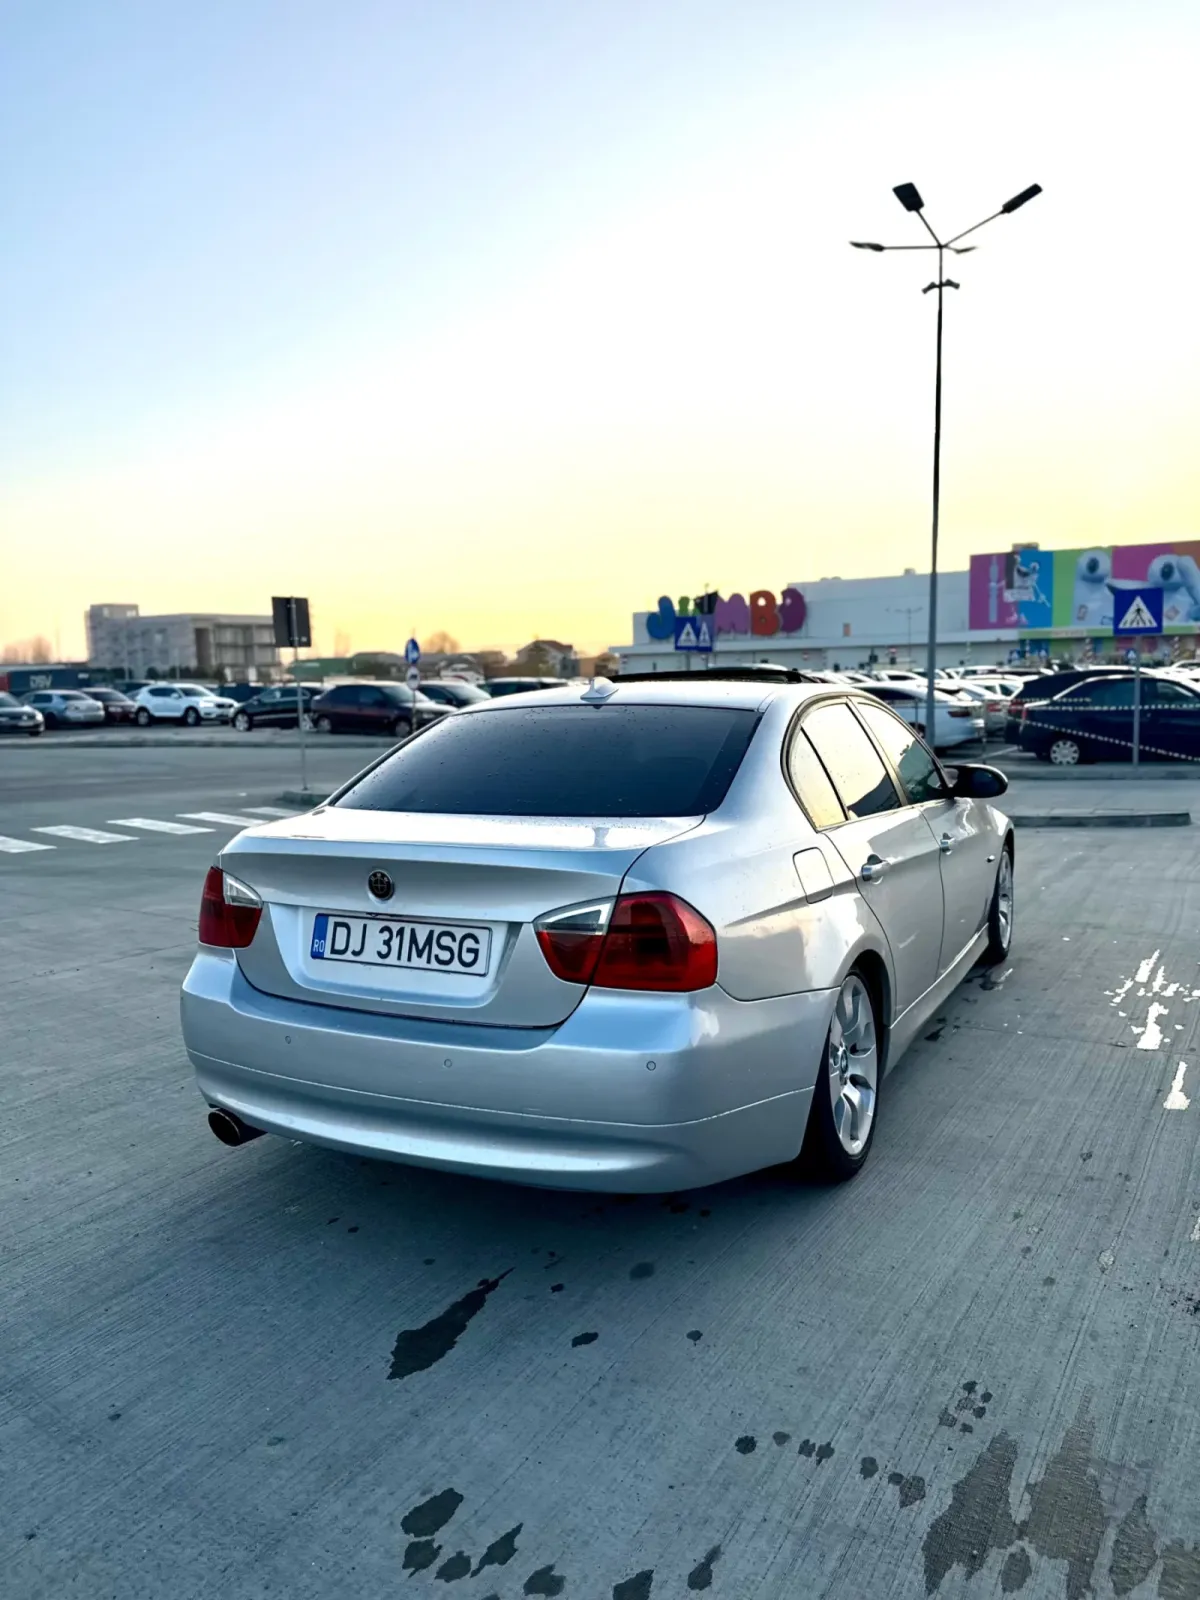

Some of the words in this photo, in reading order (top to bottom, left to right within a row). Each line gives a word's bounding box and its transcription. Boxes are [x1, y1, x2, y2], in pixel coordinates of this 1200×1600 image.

[313, 940, 325, 953] RO
[330, 921, 367, 956] DJ
[377, 926, 480, 967] 31MSG
